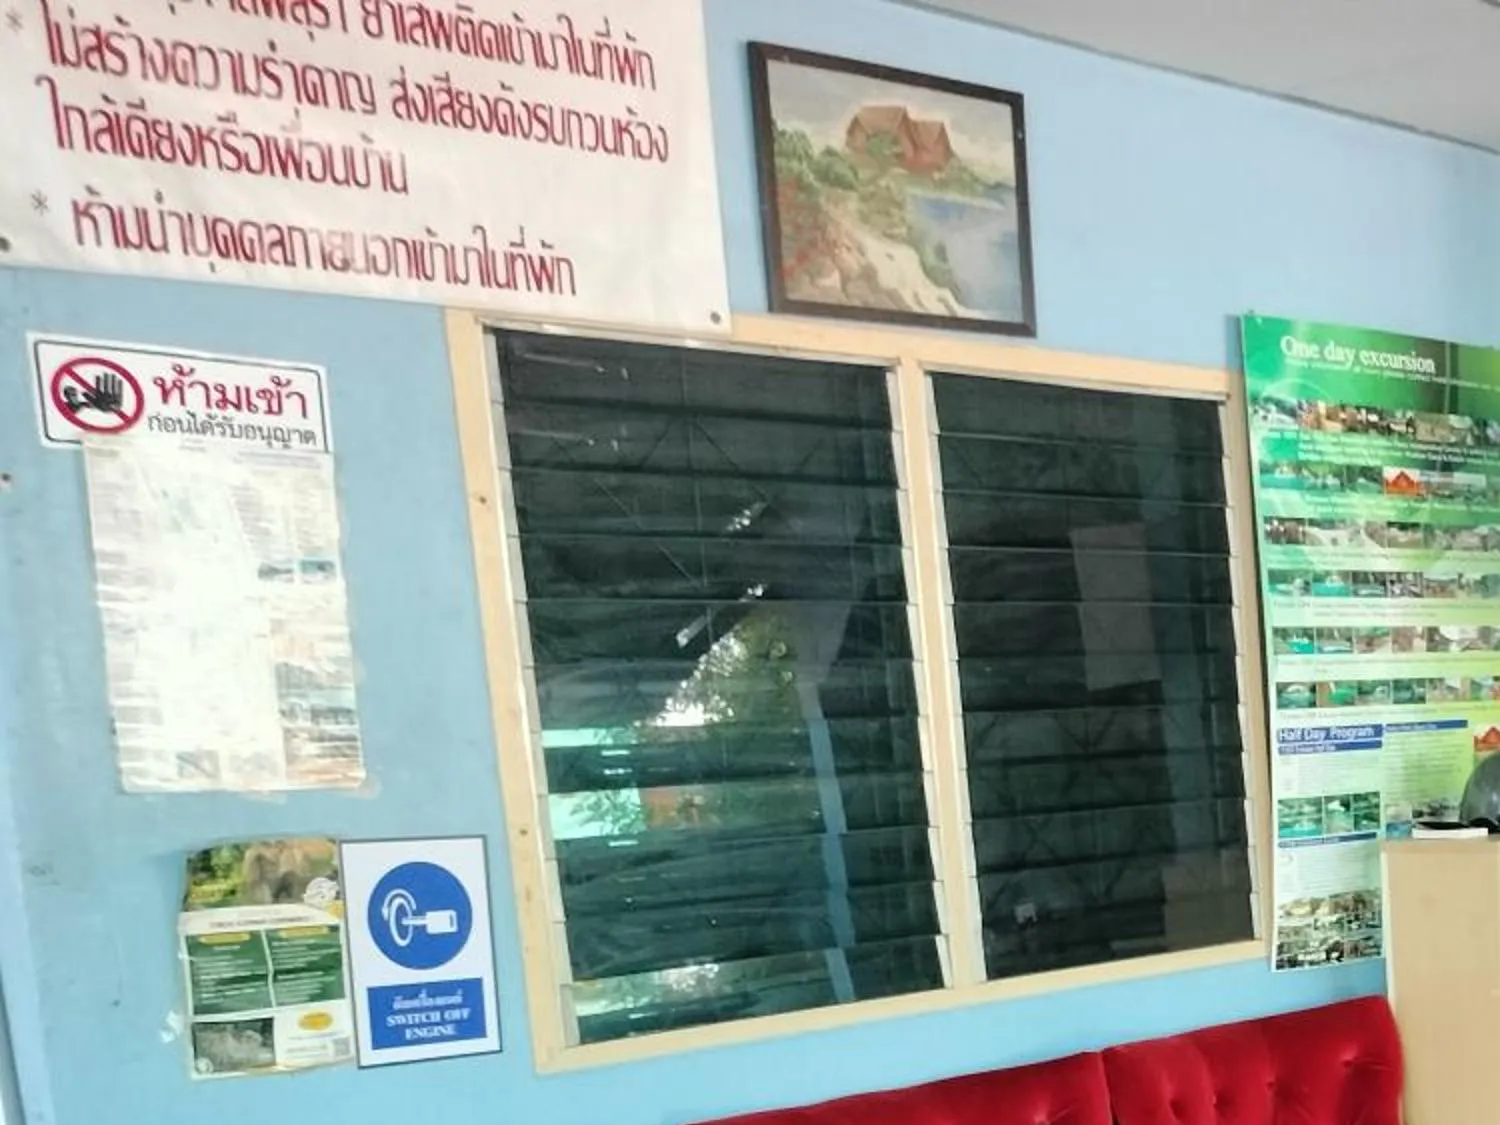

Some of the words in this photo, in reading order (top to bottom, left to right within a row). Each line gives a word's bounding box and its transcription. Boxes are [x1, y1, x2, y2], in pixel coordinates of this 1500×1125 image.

[1280, 335, 1320, 359] One
[1323, 340, 1356, 369] day
[1359, 350, 1437, 374] excursion
[153, 363, 309, 419] ห้ามเข้า
[147, 410, 318, 448] ก่อนได้รับอนุญาต
[1304, 727, 1327, 744] Day
[1330, 725, 1375, 741] Program
[385, 1011, 442, 1028] SWITCH
[443, 1007, 472, 1022] OFF
[404, 1023, 458, 1041] ENGINE
